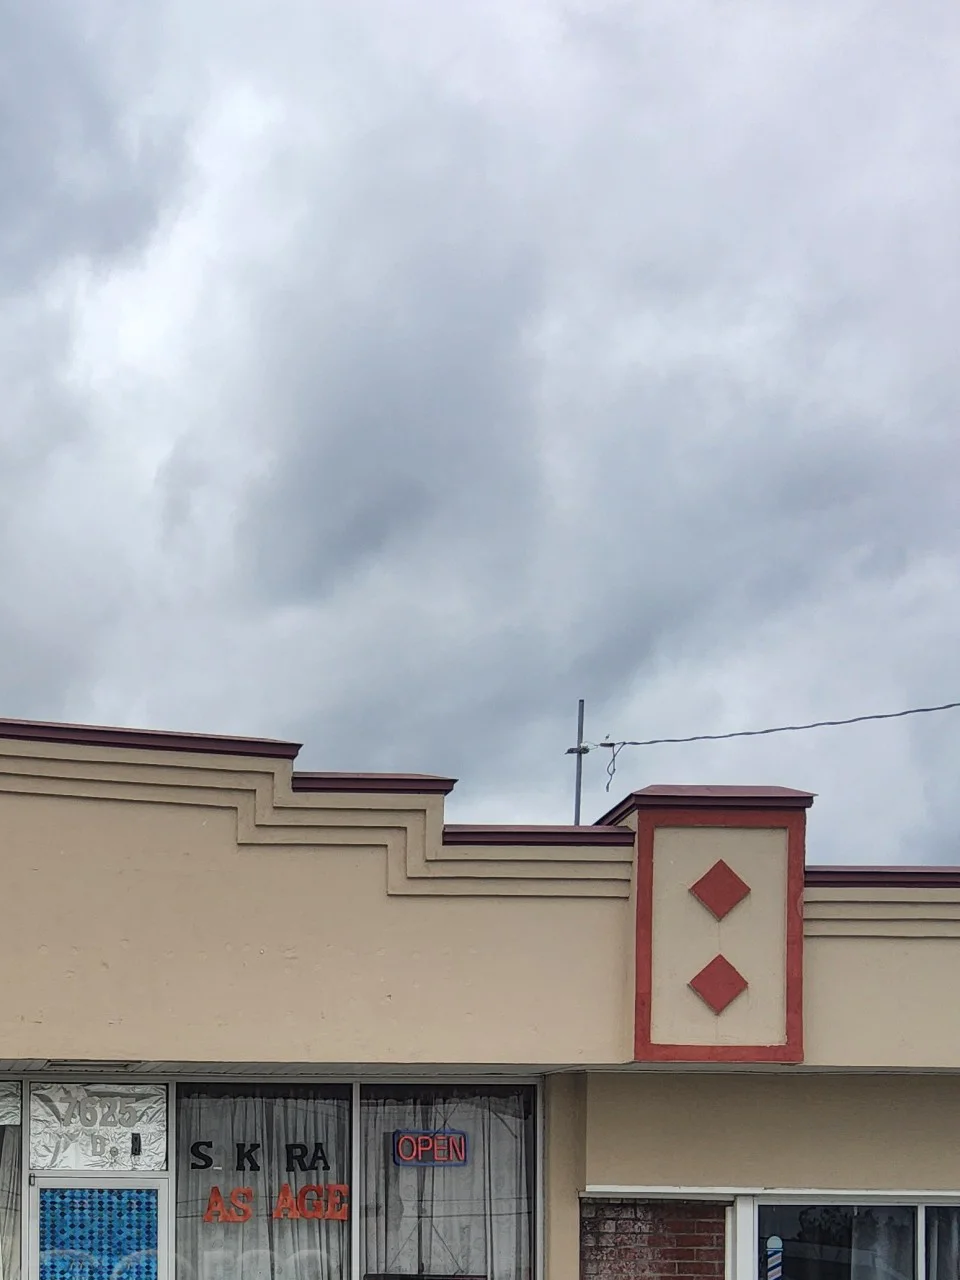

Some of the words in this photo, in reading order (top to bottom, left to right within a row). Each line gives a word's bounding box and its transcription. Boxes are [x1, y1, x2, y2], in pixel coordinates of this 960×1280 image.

[57, 1096, 137, 1127] 7625
[398, 1135, 465, 1161] OPEN
[203, 1186, 254, 1223] AS
[273, 1183, 349, 1221] AGE
